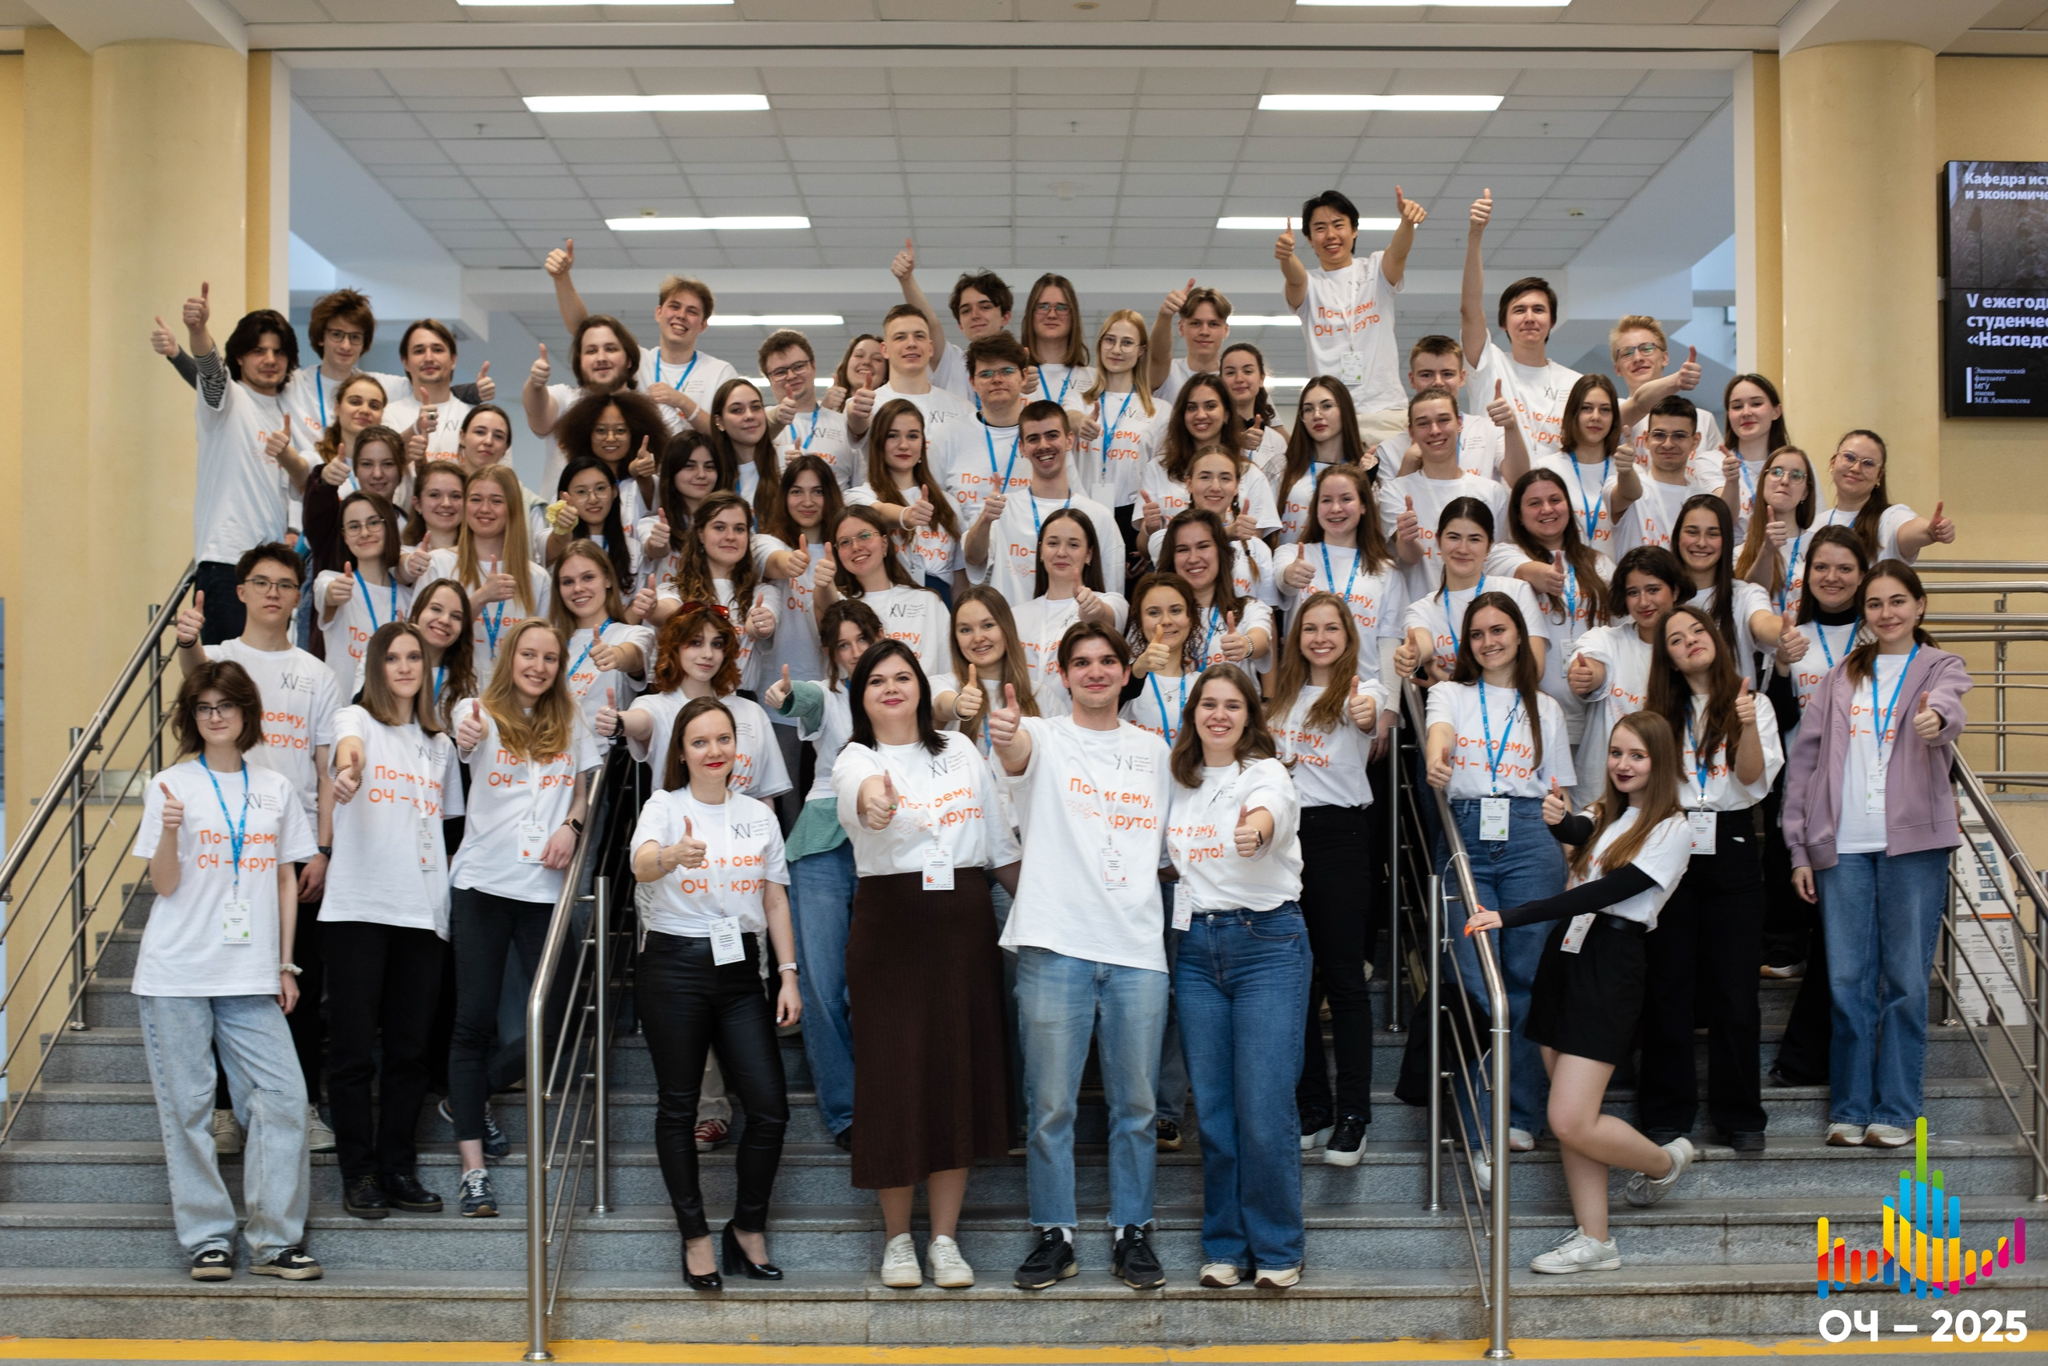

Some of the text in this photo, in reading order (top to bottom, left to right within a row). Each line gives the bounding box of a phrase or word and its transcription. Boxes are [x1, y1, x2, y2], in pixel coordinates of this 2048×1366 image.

[1965, 171, 2025, 187] Кафедра
[1965, 190, 1974, 200] и
[1966, 293, 1979, 308] V
[1314, 324, 1333, 337] ОЧ
[1966, 316, 2048, 331] студенче
[957, 490, 977, 503] ОЧ
[889, 604, 906, 618] XV
[280, 672, 299, 690] XV
[488, 771, 513, 787] ОЧ
[242, 792, 263, 810] XV
[368, 788, 395, 803] ОЧ
[730, 823, 751, 840] XV
[197, 854, 220, 869] ОЧ
[681, 879, 709, 895] ОЧ
